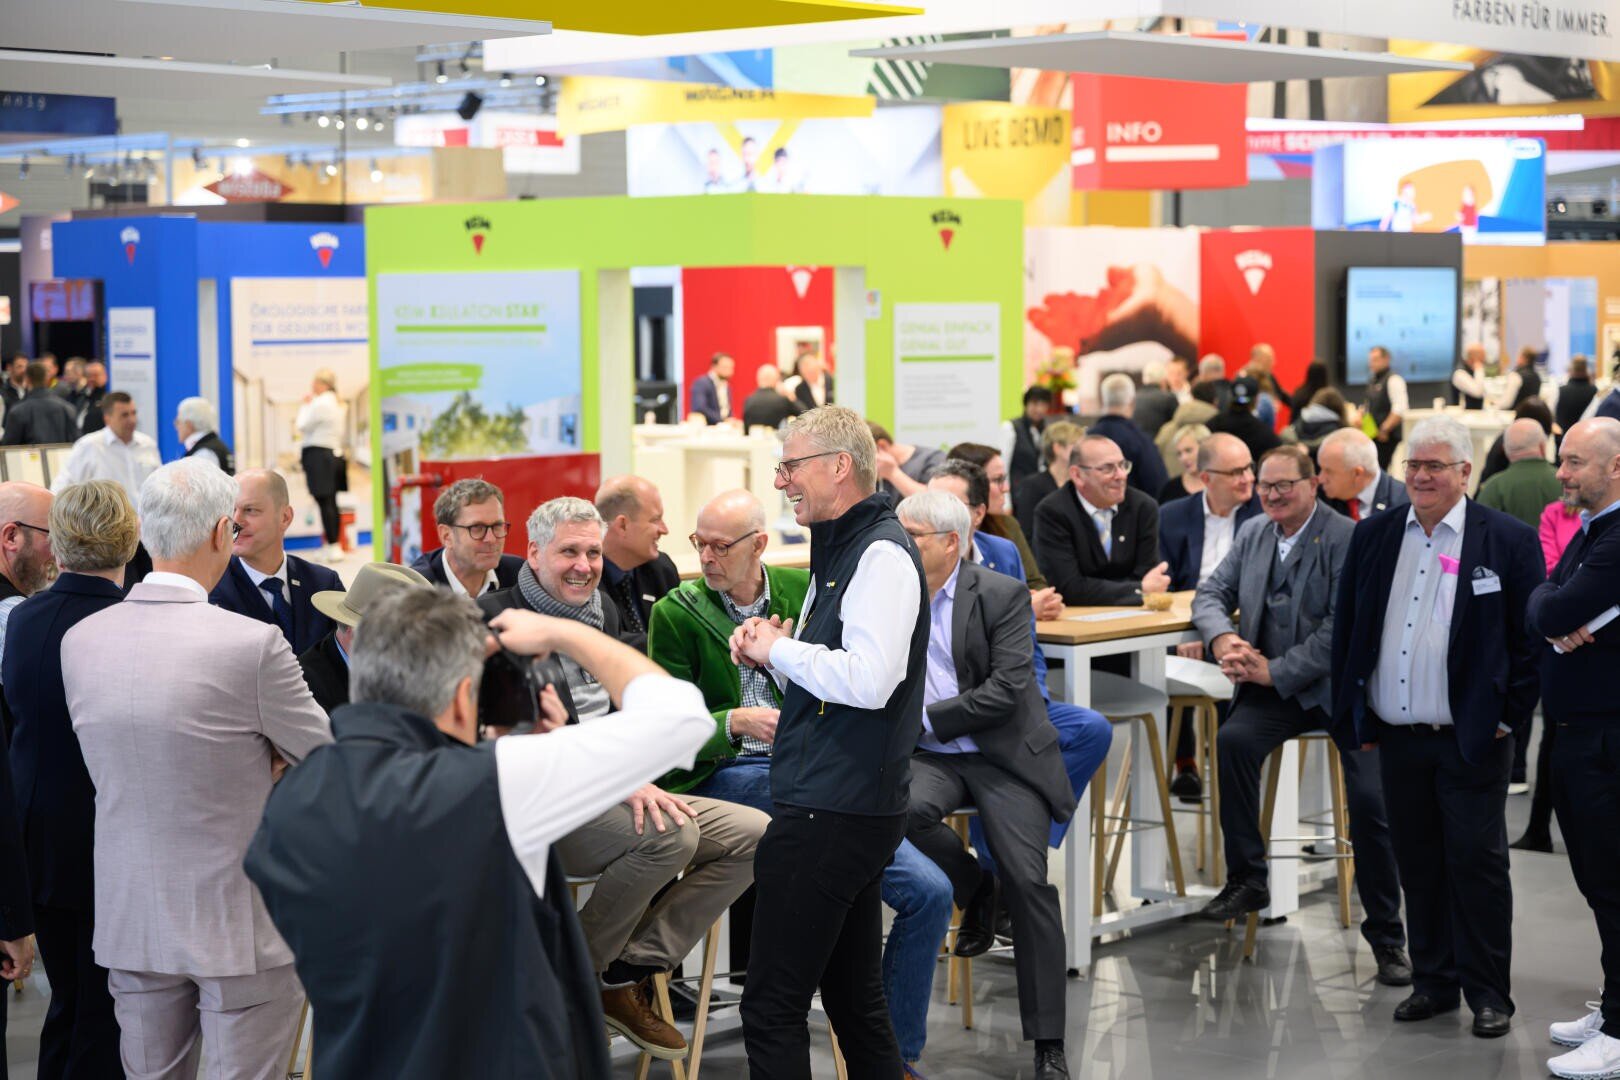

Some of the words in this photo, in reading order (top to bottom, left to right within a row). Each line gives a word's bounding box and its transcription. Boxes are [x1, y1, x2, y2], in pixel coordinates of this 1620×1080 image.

[1453, 0, 1516, 27] FARBEN
[1522, 2, 1551, 31] FÜR
[1556, 8, 1612, 38] IMMER.
[963, 116, 1001, 149] LIVE
[1009, 115, 1064, 147] DEMO
[1106, 121, 1163, 143] INFO
